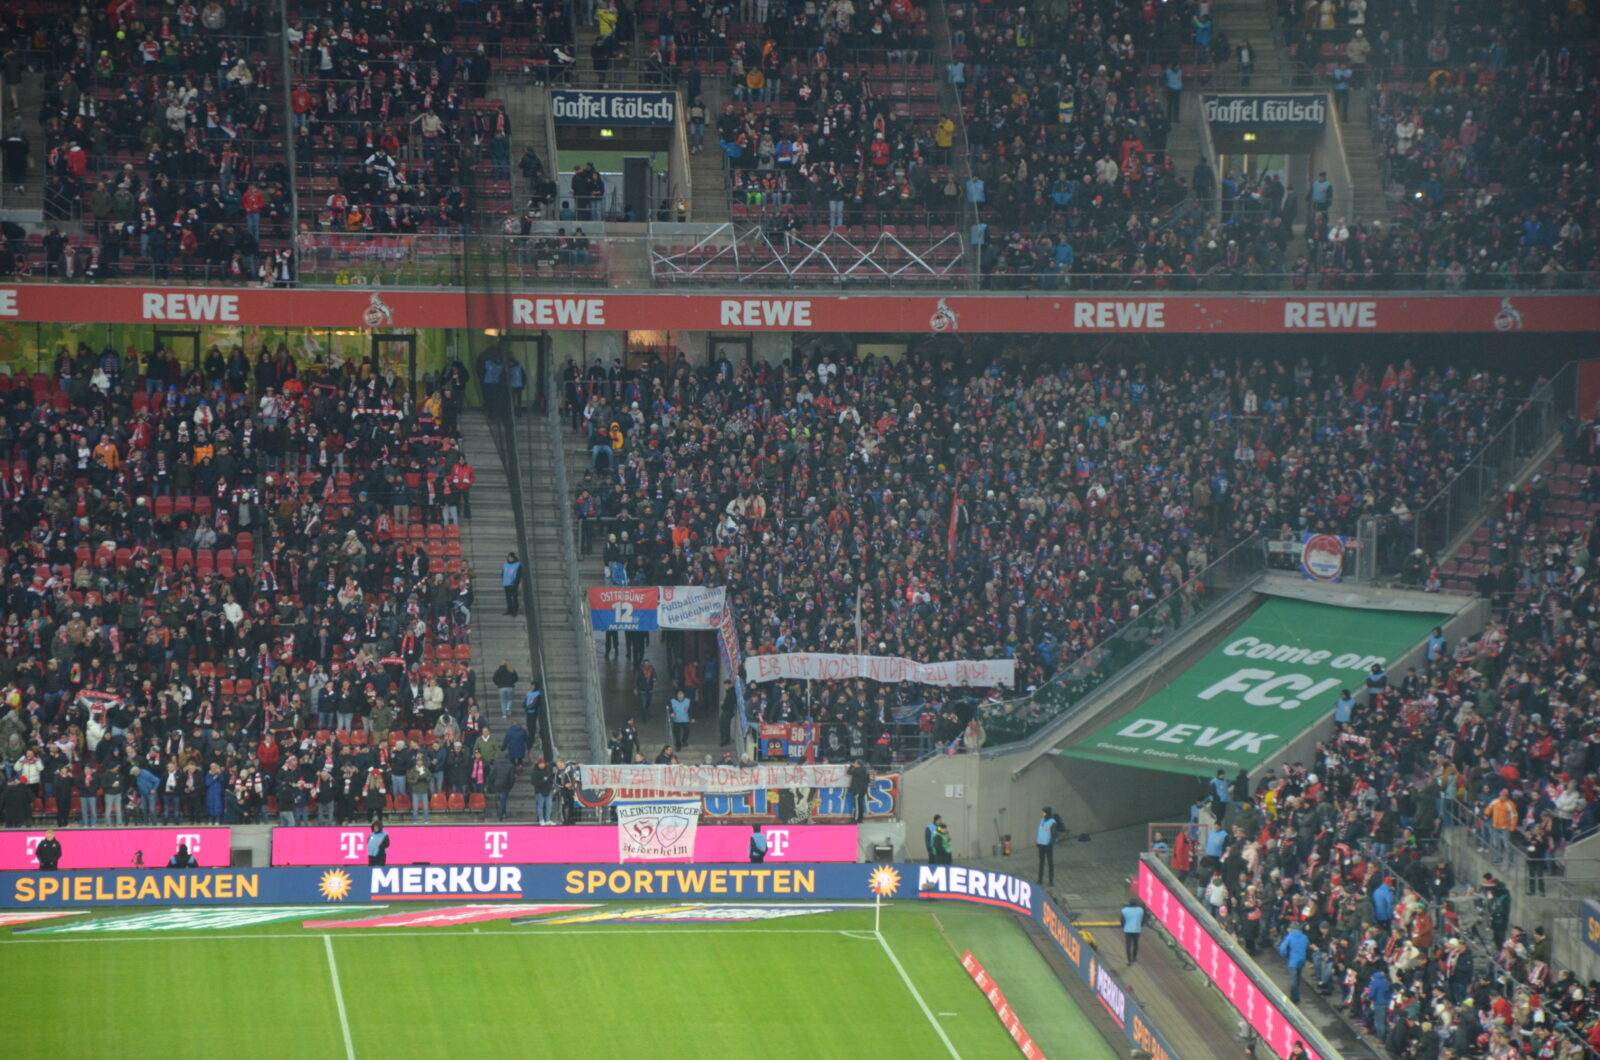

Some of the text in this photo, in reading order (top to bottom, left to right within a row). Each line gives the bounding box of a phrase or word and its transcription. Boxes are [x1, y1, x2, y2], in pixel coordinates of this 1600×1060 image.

[552, 92, 673, 121] Gaffel Kölsch
[1205, 99, 1325, 124] Gaffel Kölsch
[142, 293, 240, 321] REWE
[512, 299, 606, 325] REWE
[720, 299, 813, 326] REWE
[1073, 302, 1165, 328] REWE
[1284, 302, 1377, 328] REWE
[600, 591, 645, 603] OSTTRIBÜNE
[667, 602, 721, 625] Heidenheim
[1223, 637, 1331, 665] Come
[1197, 667, 1342, 710] FC!
[1116, 718, 1280, 754] DEVK
[619, 804, 699, 818] KLEINSTADTKRIEGER
[340, 832, 364, 859] T
[484, 831, 508, 858] T
[766, 829, 790, 857] T
[15, 874, 259, 902] SPIELBANKEN
[371, 866, 522, 893] MERKUR
[565, 869, 815, 894] SPORTWETTEN
[918, 865, 1032, 909] MERKUR
[1042, 901, 1081, 967] SPIELHALLEN
[1097, 964, 1126, 1023] MERKUR
